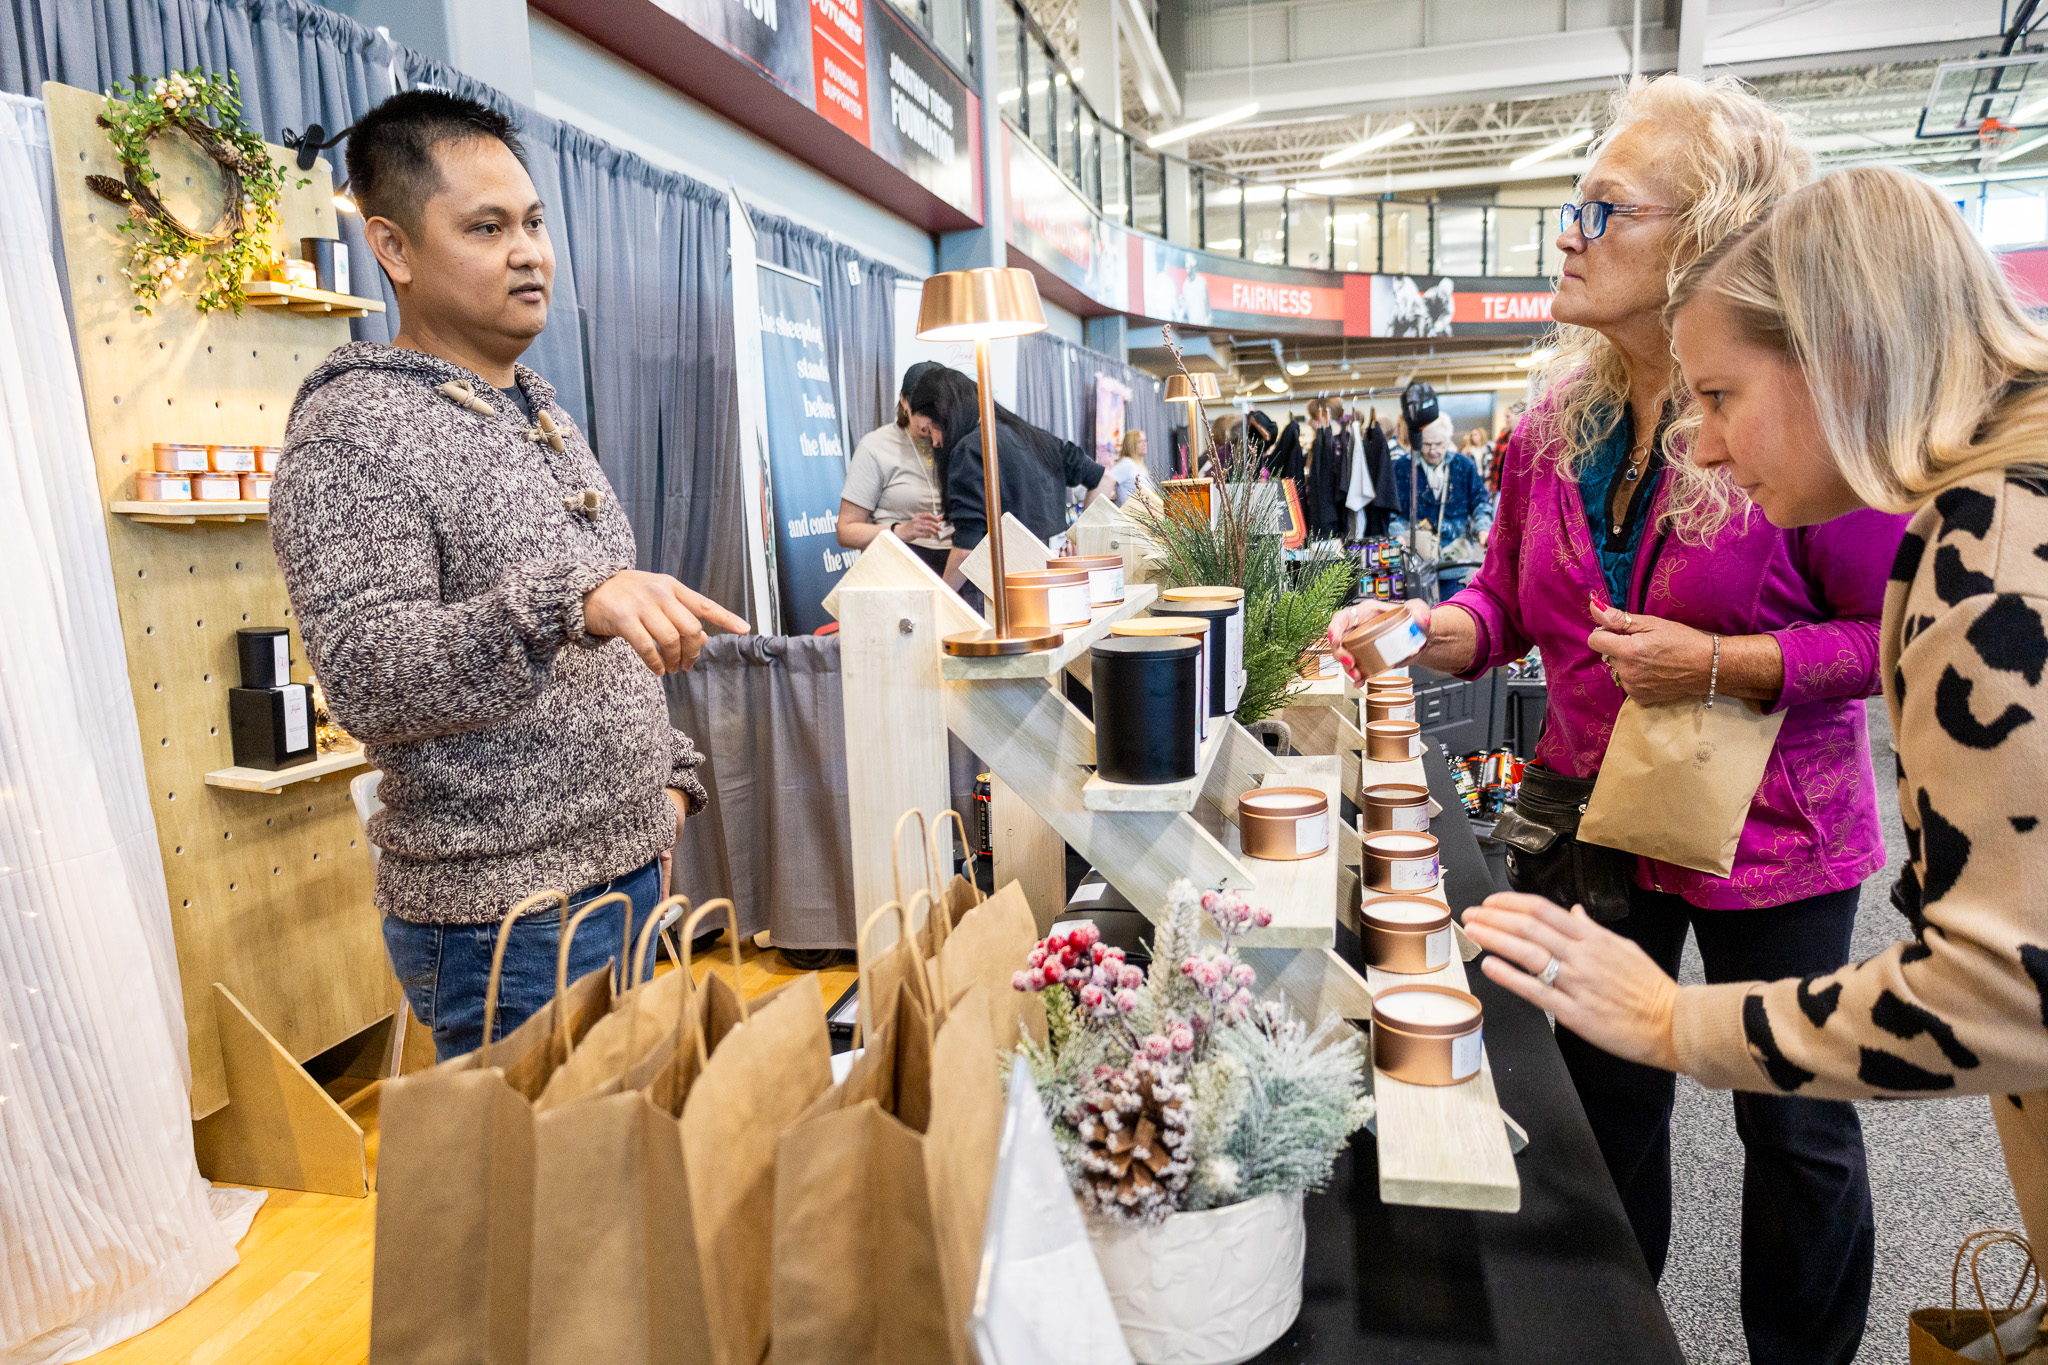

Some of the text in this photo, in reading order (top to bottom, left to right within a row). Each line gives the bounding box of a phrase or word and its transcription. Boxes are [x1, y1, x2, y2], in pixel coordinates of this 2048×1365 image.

[822, 78, 863, 120] SUPPORTER
[890, 86, 955, 167] FOUNDATION
[1232, 283, 1312, 315] FAIRNESS
[1481, 296, 1554, 320] TEAMW
[797, 357, 830, 383] stands
[802, 392, 836, 420] before
[800, 432, 844, 457] the flock
[788, 509, 840, 538] and confr
[823, 547, 843, 573] the
